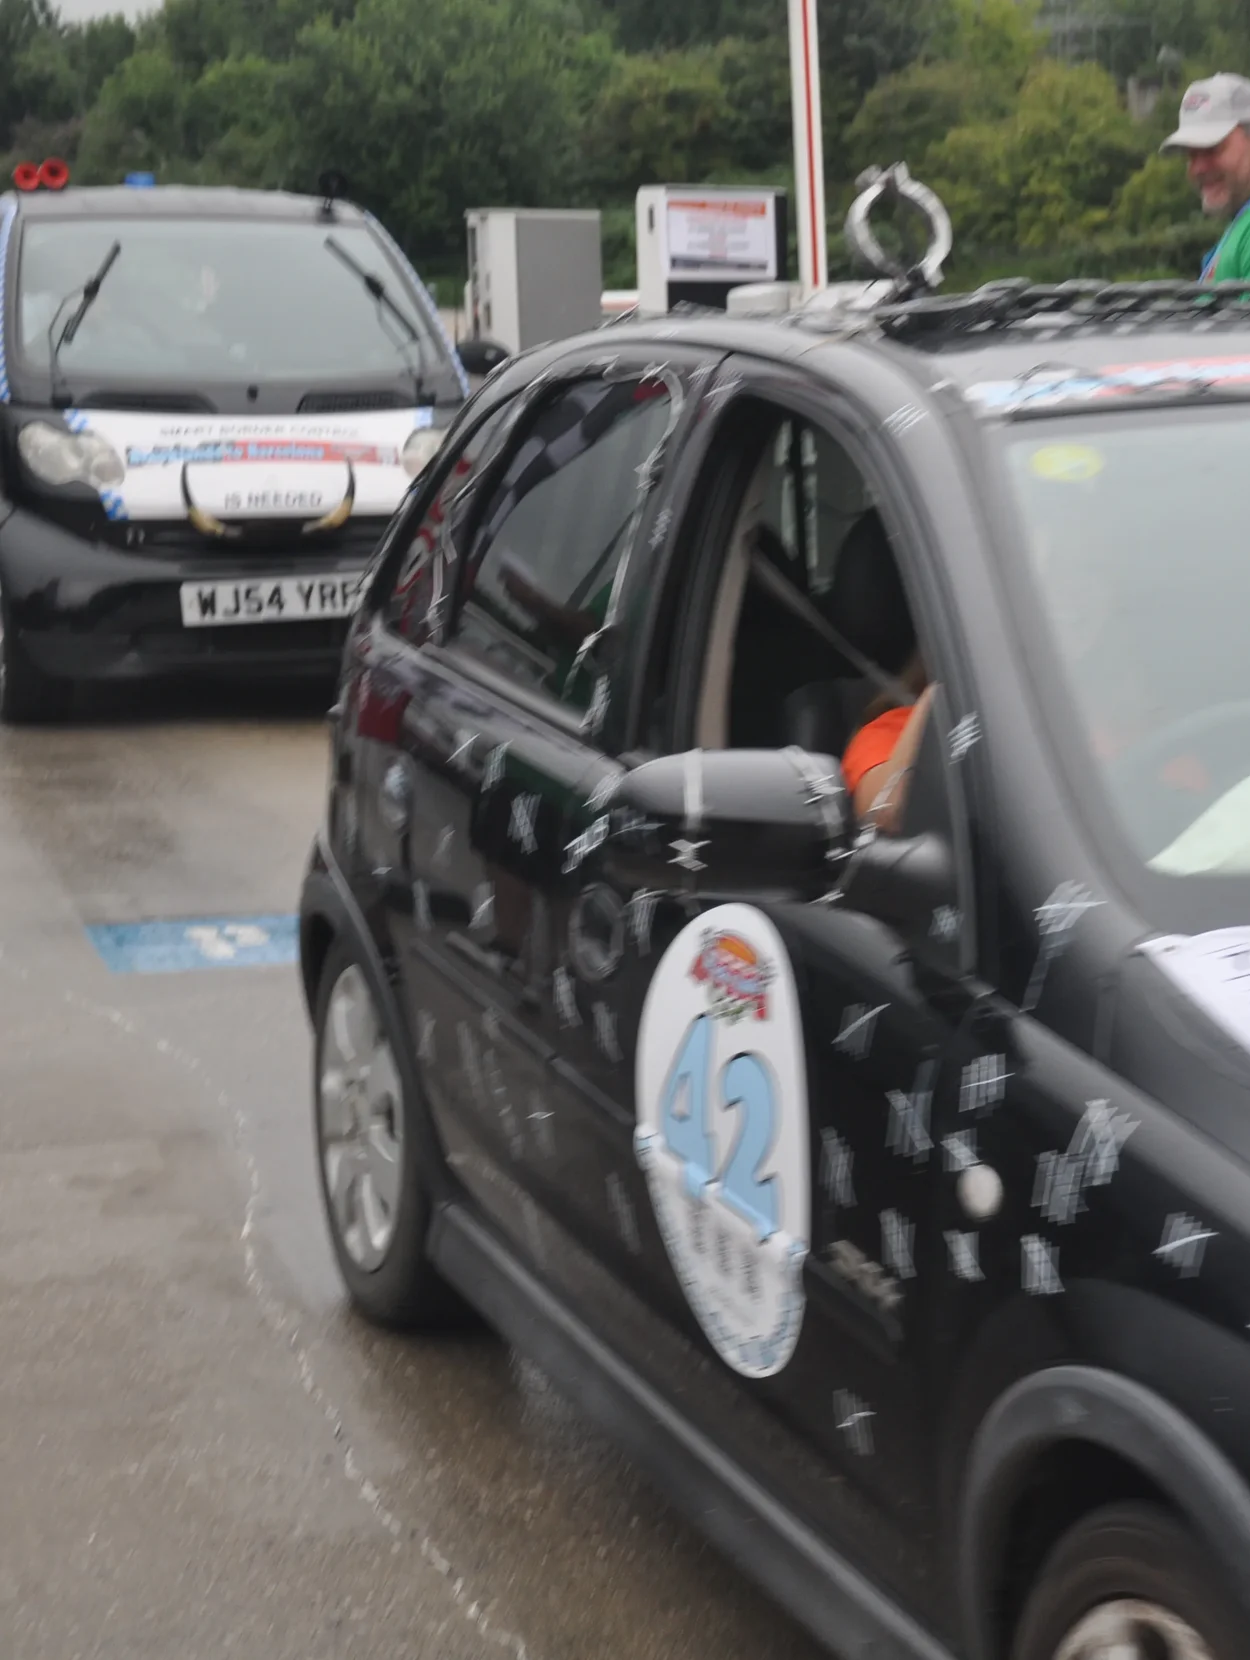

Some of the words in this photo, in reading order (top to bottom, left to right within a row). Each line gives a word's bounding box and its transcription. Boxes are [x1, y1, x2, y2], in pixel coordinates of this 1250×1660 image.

[224, 491, 242, 510] IS
[247, 488, 323, 509] NEEDED
[196, 586, 286, 618] WJ54
[661, 1012, 779, 1238] 42
